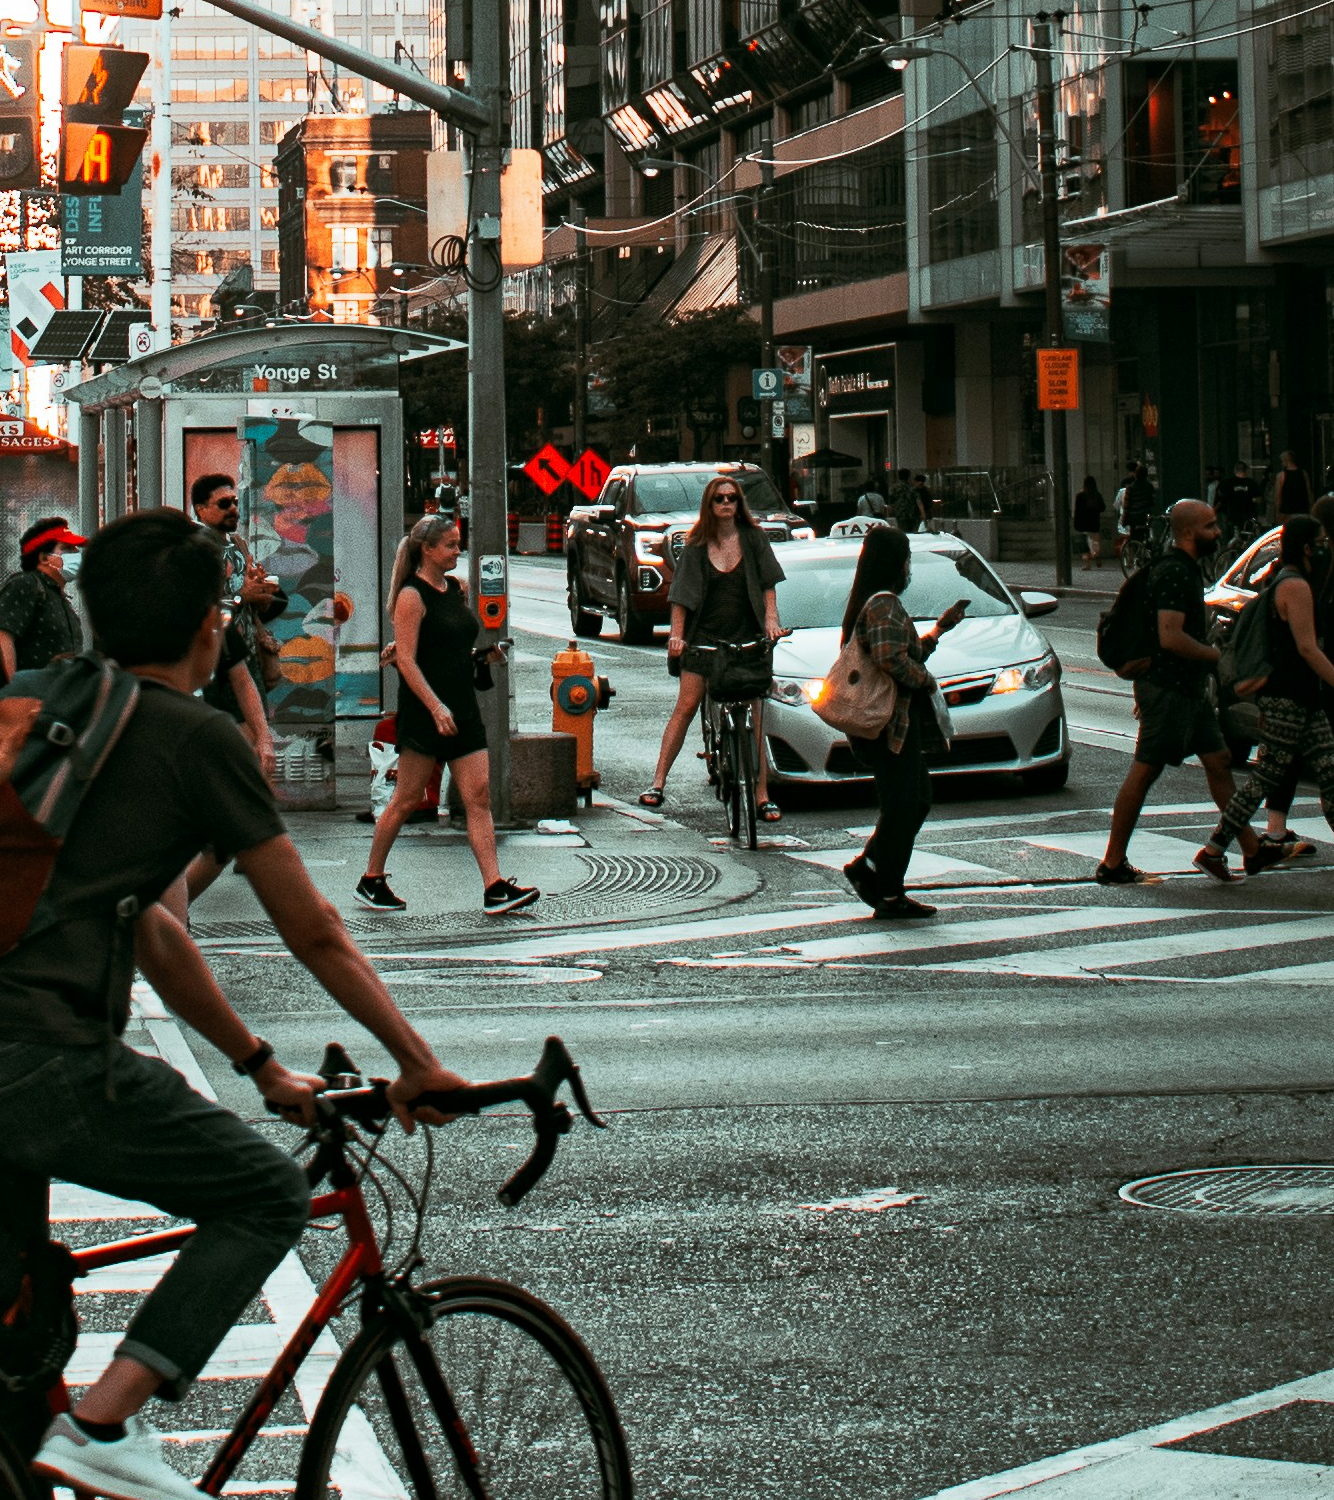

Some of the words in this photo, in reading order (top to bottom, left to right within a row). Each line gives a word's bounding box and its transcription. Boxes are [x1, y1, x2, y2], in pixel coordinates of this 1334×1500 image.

[65, 246, 83, 255] ART
[85, 246, 133, 255] CORRIDOR
[65, 257, 98, 266] YONGE
[98, 257, 132, 266] STREET
[253, 364, 310, 384] Yonge
[317, 363, 337, 380] St
[838, 522, 883, 536] TAX
